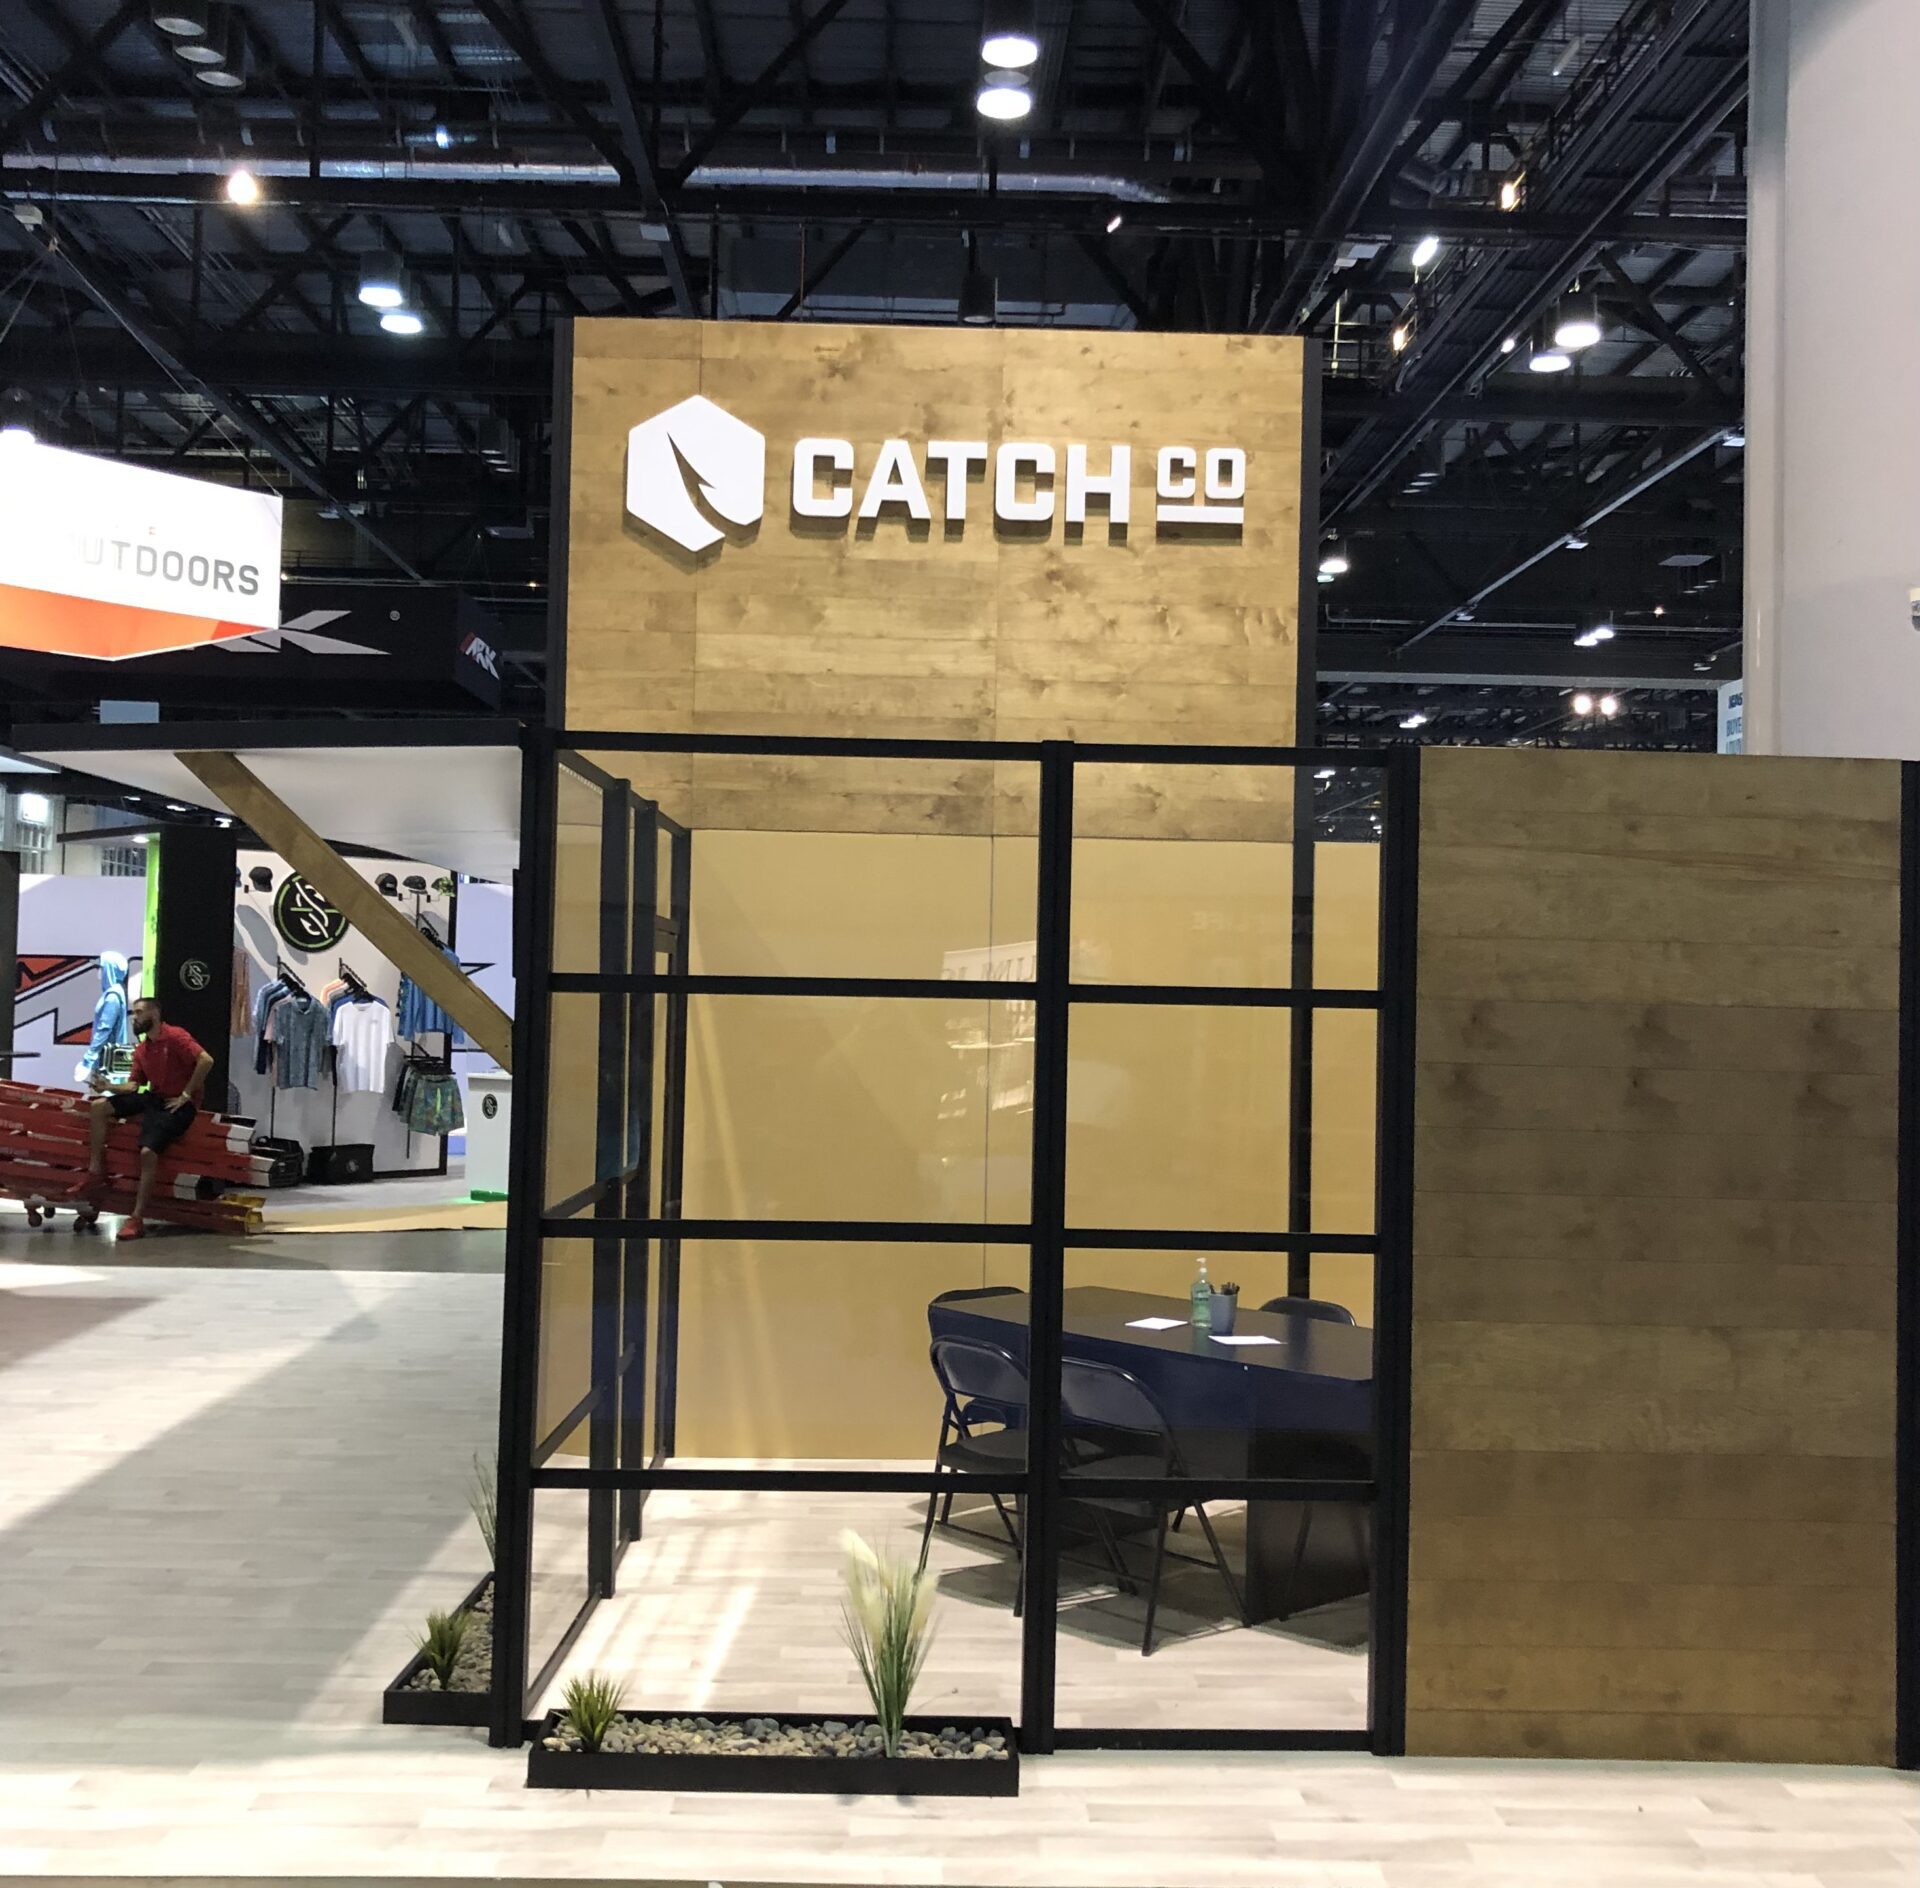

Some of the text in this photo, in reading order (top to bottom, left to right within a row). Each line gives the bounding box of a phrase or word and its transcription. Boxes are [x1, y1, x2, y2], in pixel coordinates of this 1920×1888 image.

[792, 438, 1246, 524] CATCH CO
[70, 533, 260, 597] UTDOORS
